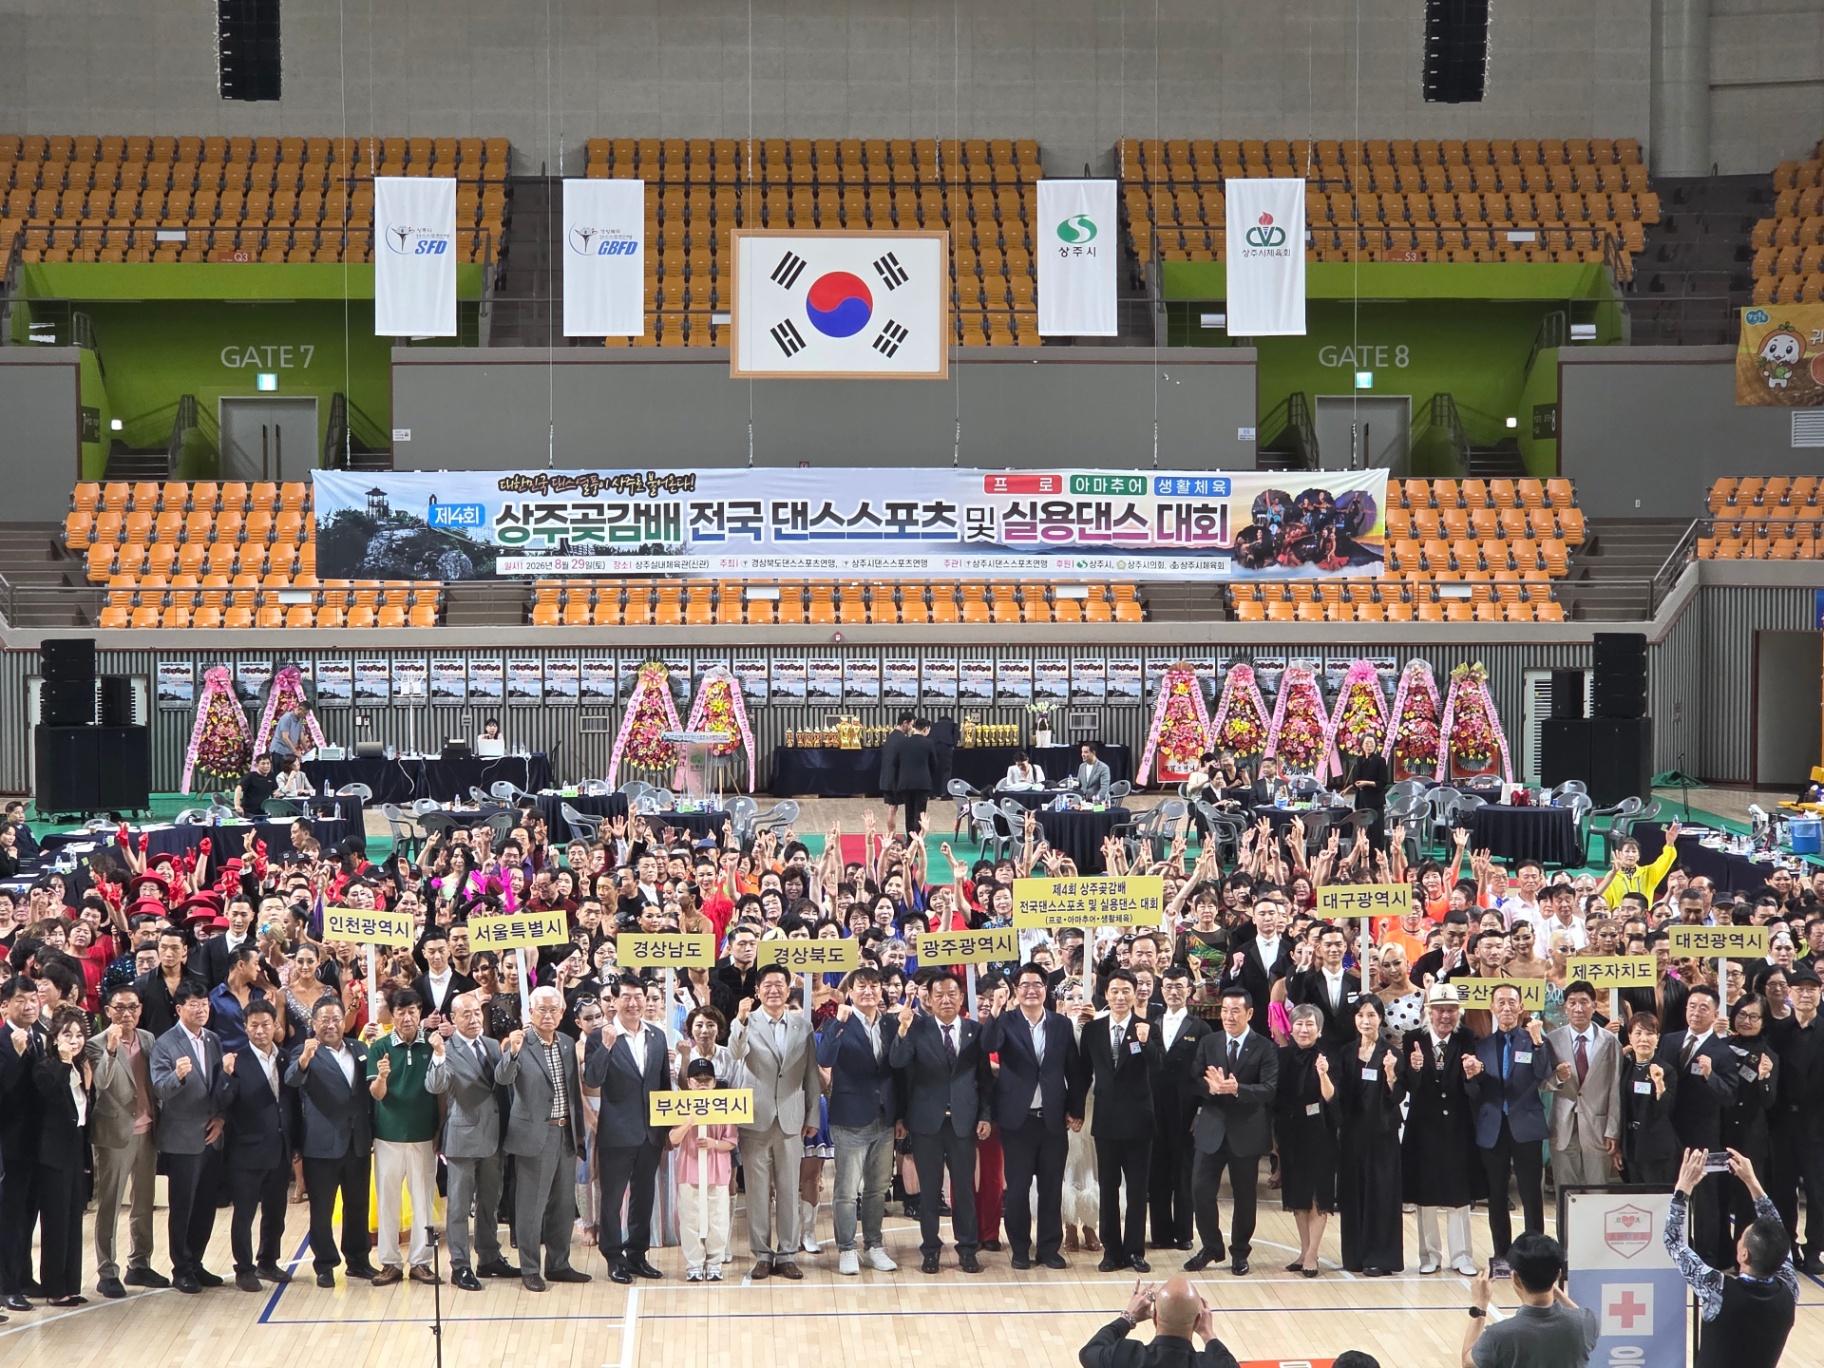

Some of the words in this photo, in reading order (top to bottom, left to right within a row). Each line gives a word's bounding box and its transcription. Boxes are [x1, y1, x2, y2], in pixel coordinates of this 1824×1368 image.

[415, 240, 448, 255] SFD
[598, 240, 638, 255] GBFD
[1058, 246, 1097, 258] 상주시
[1242, 248, 1291, 258] 상주시체육회
[234, 252, 249, 262] Q3
[1404, 252, 1417, 262] S3
[220, 345, 294, 368] GATE
[300, 345, 315, 369] 7
[1318, 345, 1389, 368] GATE
[1395, 344, 1410, 368] 8
[499, 474, 549, 496] 대한민국
[611, 475, 645, 496] 상주로
[647, 472, 695, 497] 불어온다!
[1075, 477, 1143, 494] 아마추어
[1158, 479, 1226, 495] 생활체육
[434, 507, 479, 524] 제4회
[495, 502, 681, 543] 상주곶감배
[689, 501, 764, 541] 전국
[771, 500, 958, 541] 댄스스포츠
[966, 506, 995, 540] 및
[1001, 500, 1149, 541] 실용댄스
[1156, 503, 1229, 543] 대회
[526, 561, 553, 570] 2026년
[554, 559, 569, 570] 8월
[571, 559, 606, 571] 29일(토)
[635, 560, 709, 570] 상주실내체육관(신관)
[851, 559, 928, 568] 상주시댄스스포츠연맹
[972, 559, 1048, 568] 상주시댄스스포츠연맹
[1180, 561, 1225, 570] 상주시체육회
[1052, 882, 1077, 897] 제4회
[1080, 881, 1126, 896] 상주곶감배
[1019, 899, 1085, 914] 전국댄스스포츠
[1088, 899, 1098, 912] 및
[1100, 898, 1137, 912] 실용댄스
[1141, 897, 1159, 911] 대회
[1323, 890, 1407, 911] 대구광역시
[329, 915, 410, 939] 인천광역시
[474, 918, 562, 943] 서울특별시
[922, 935, 1012, 958] 광주광역시
[1675, 932, 1762, 950] 대전광역시
[633, 940, 702, 960] 경상남도
[773, 946, 845, 966] 경상북도
[1572, 962, 1652, 981] 제주자치도
[1456, 984, 1539, 1002] 울산시
[655, 1096, 747, 1117] 부산광역시
